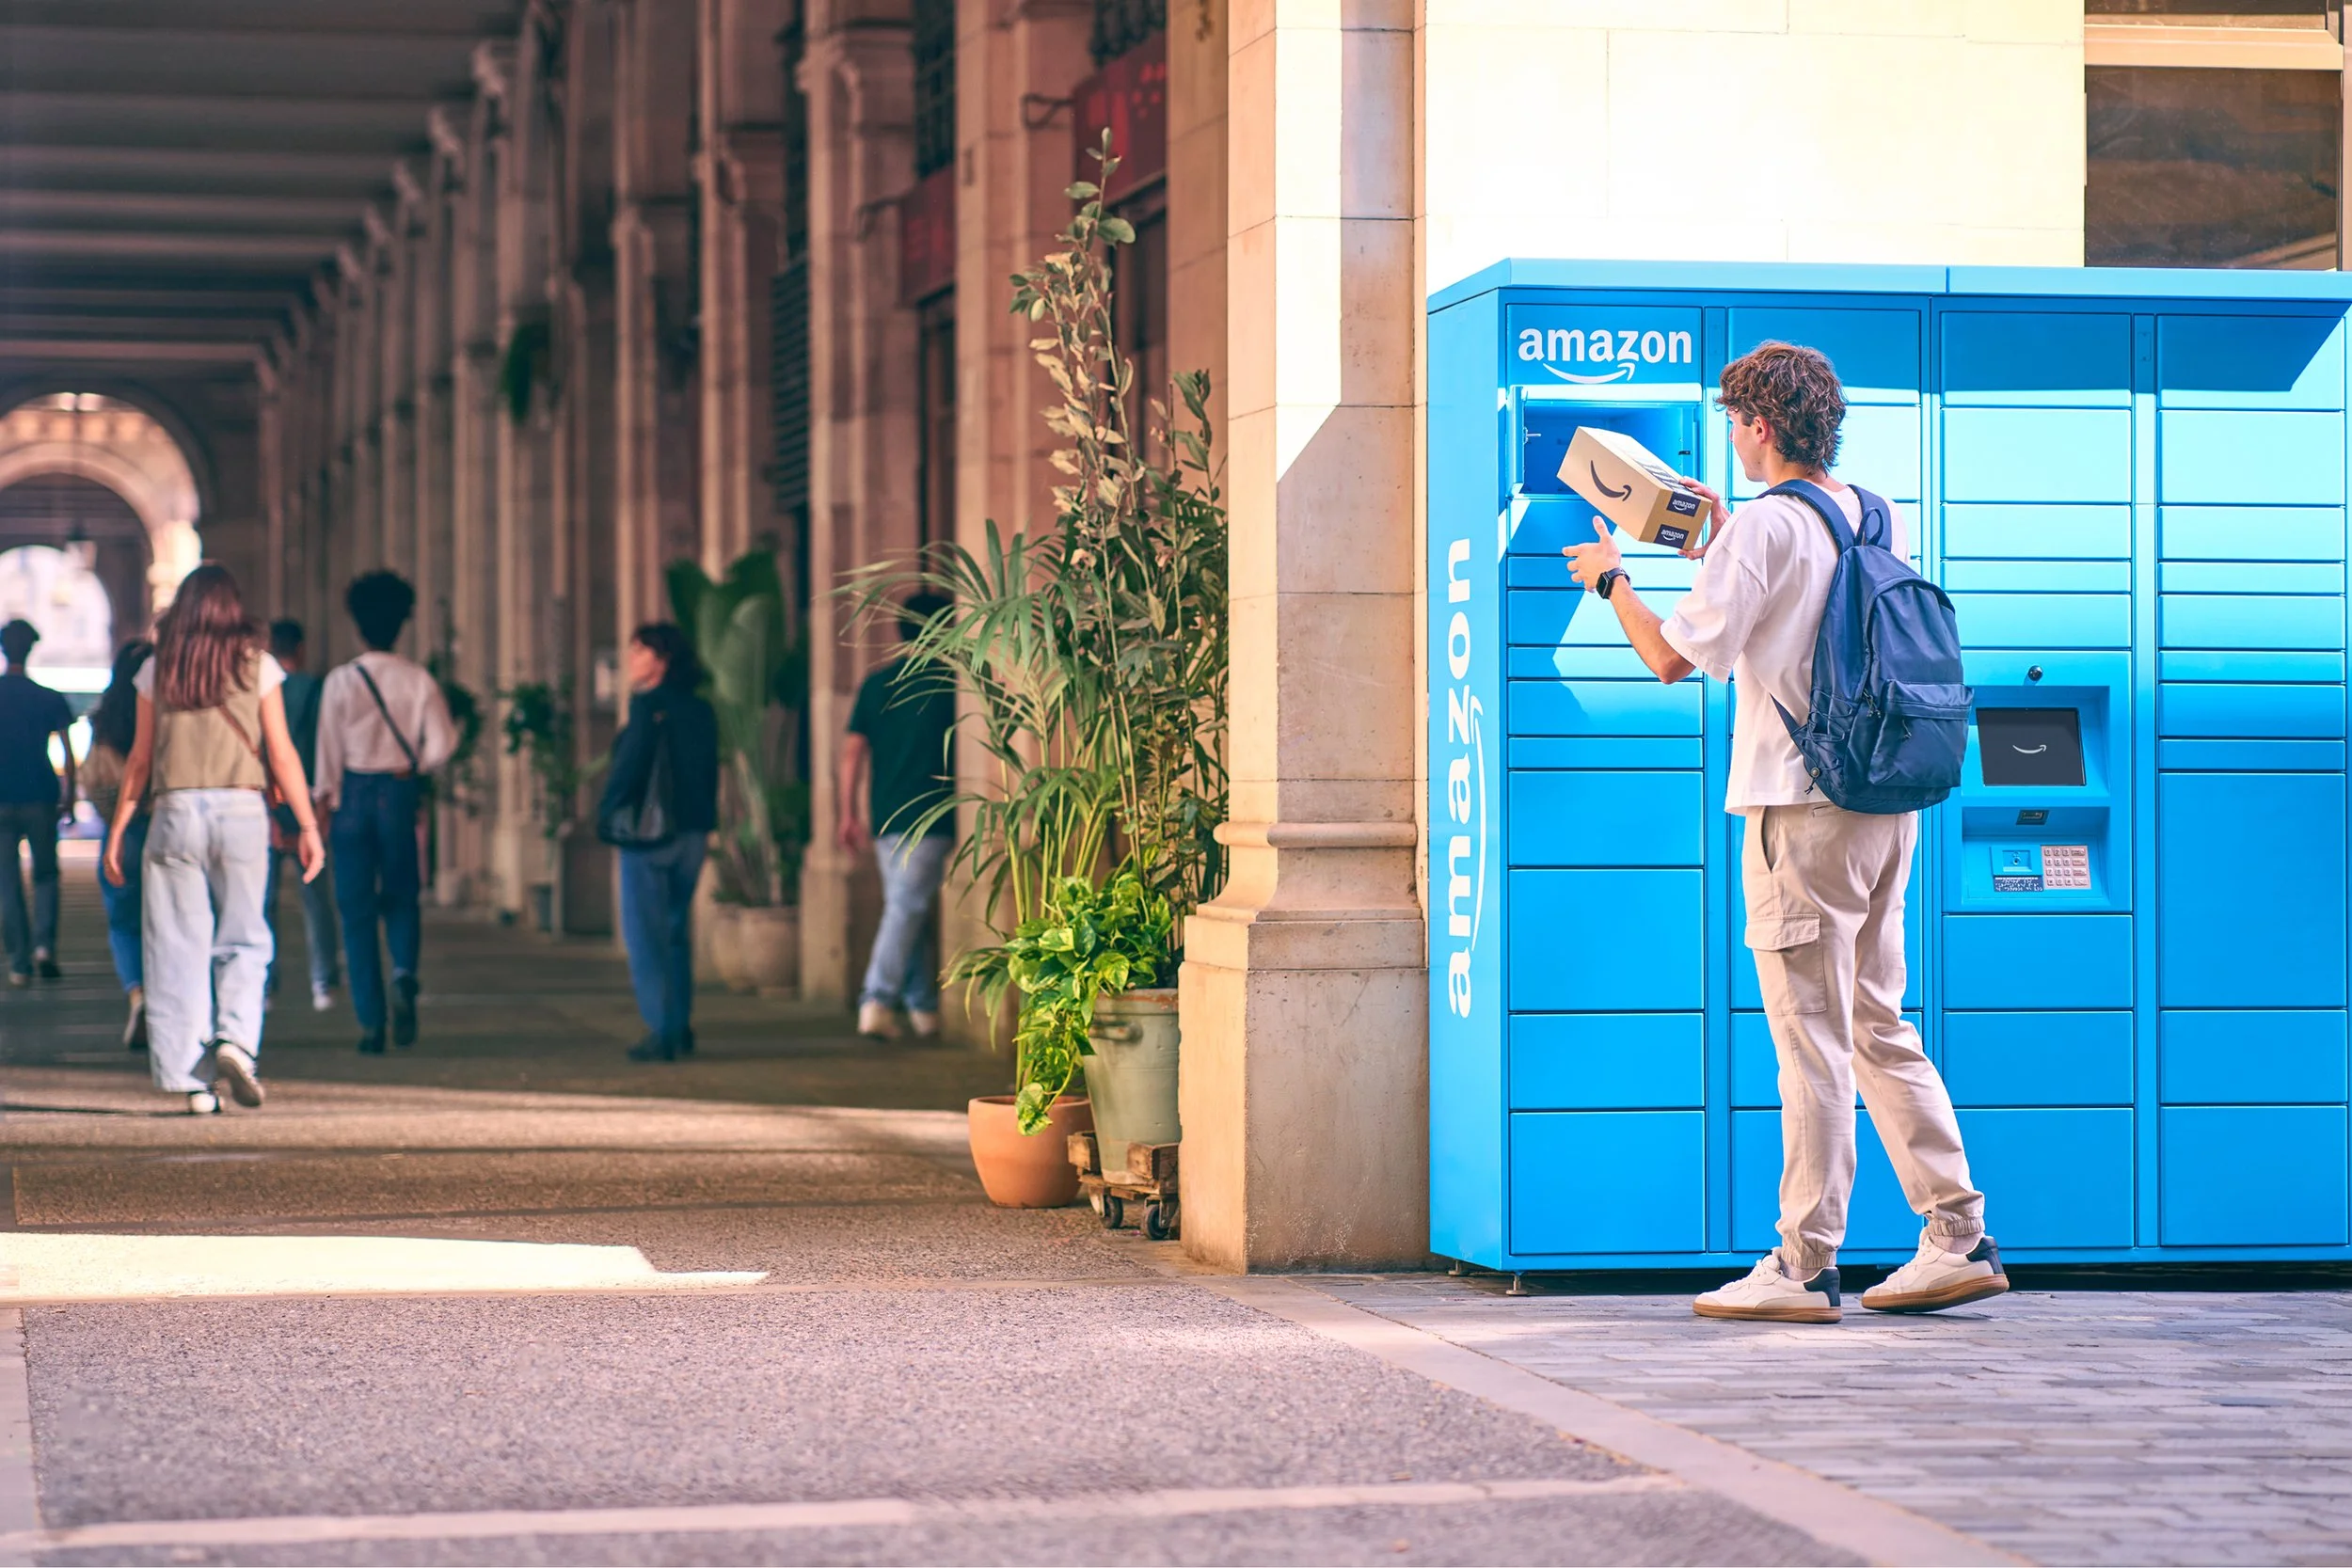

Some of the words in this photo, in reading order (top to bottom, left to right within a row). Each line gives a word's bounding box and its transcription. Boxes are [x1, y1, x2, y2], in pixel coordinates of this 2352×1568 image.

[1518, 328, 1692, 364] amazon
[1672, 499, 1696, 510] amazon
[1661, 529, 1685, 539] amazon
[1447, 537, 1472, 1019] amazon
